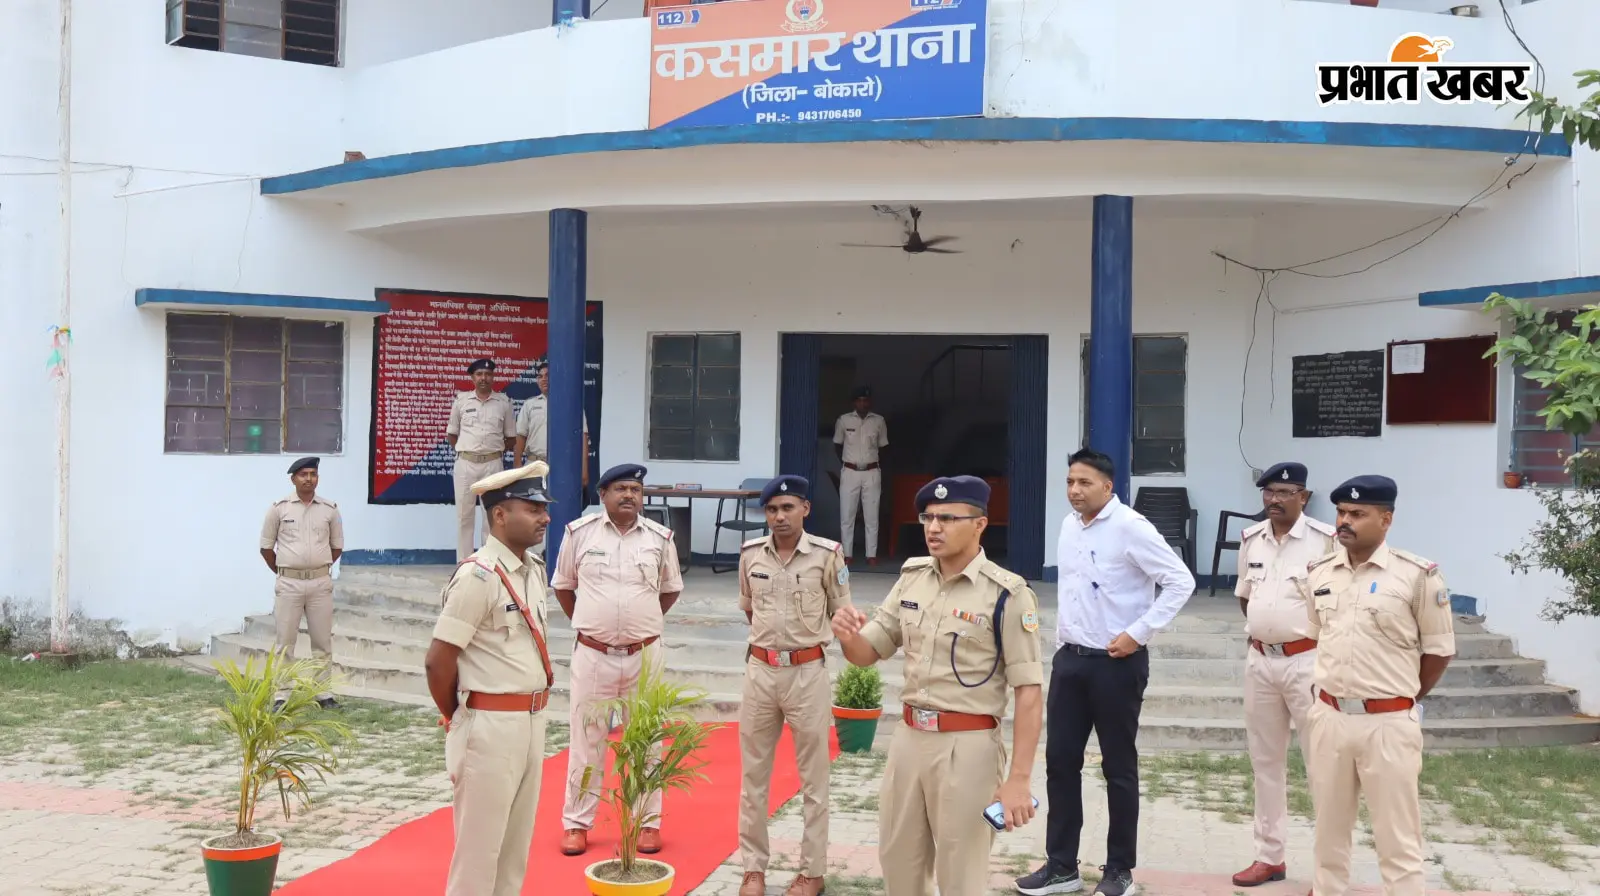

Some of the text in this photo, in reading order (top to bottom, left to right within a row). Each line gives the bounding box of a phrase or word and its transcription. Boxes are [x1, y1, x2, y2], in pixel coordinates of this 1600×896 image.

[658, 12, 682, 24] 112
[654, 23, 977, 81] कसमार थाना
[813, 75, 883, 102] बोकारो)
[797, 108, 862, 121] 9431706450
